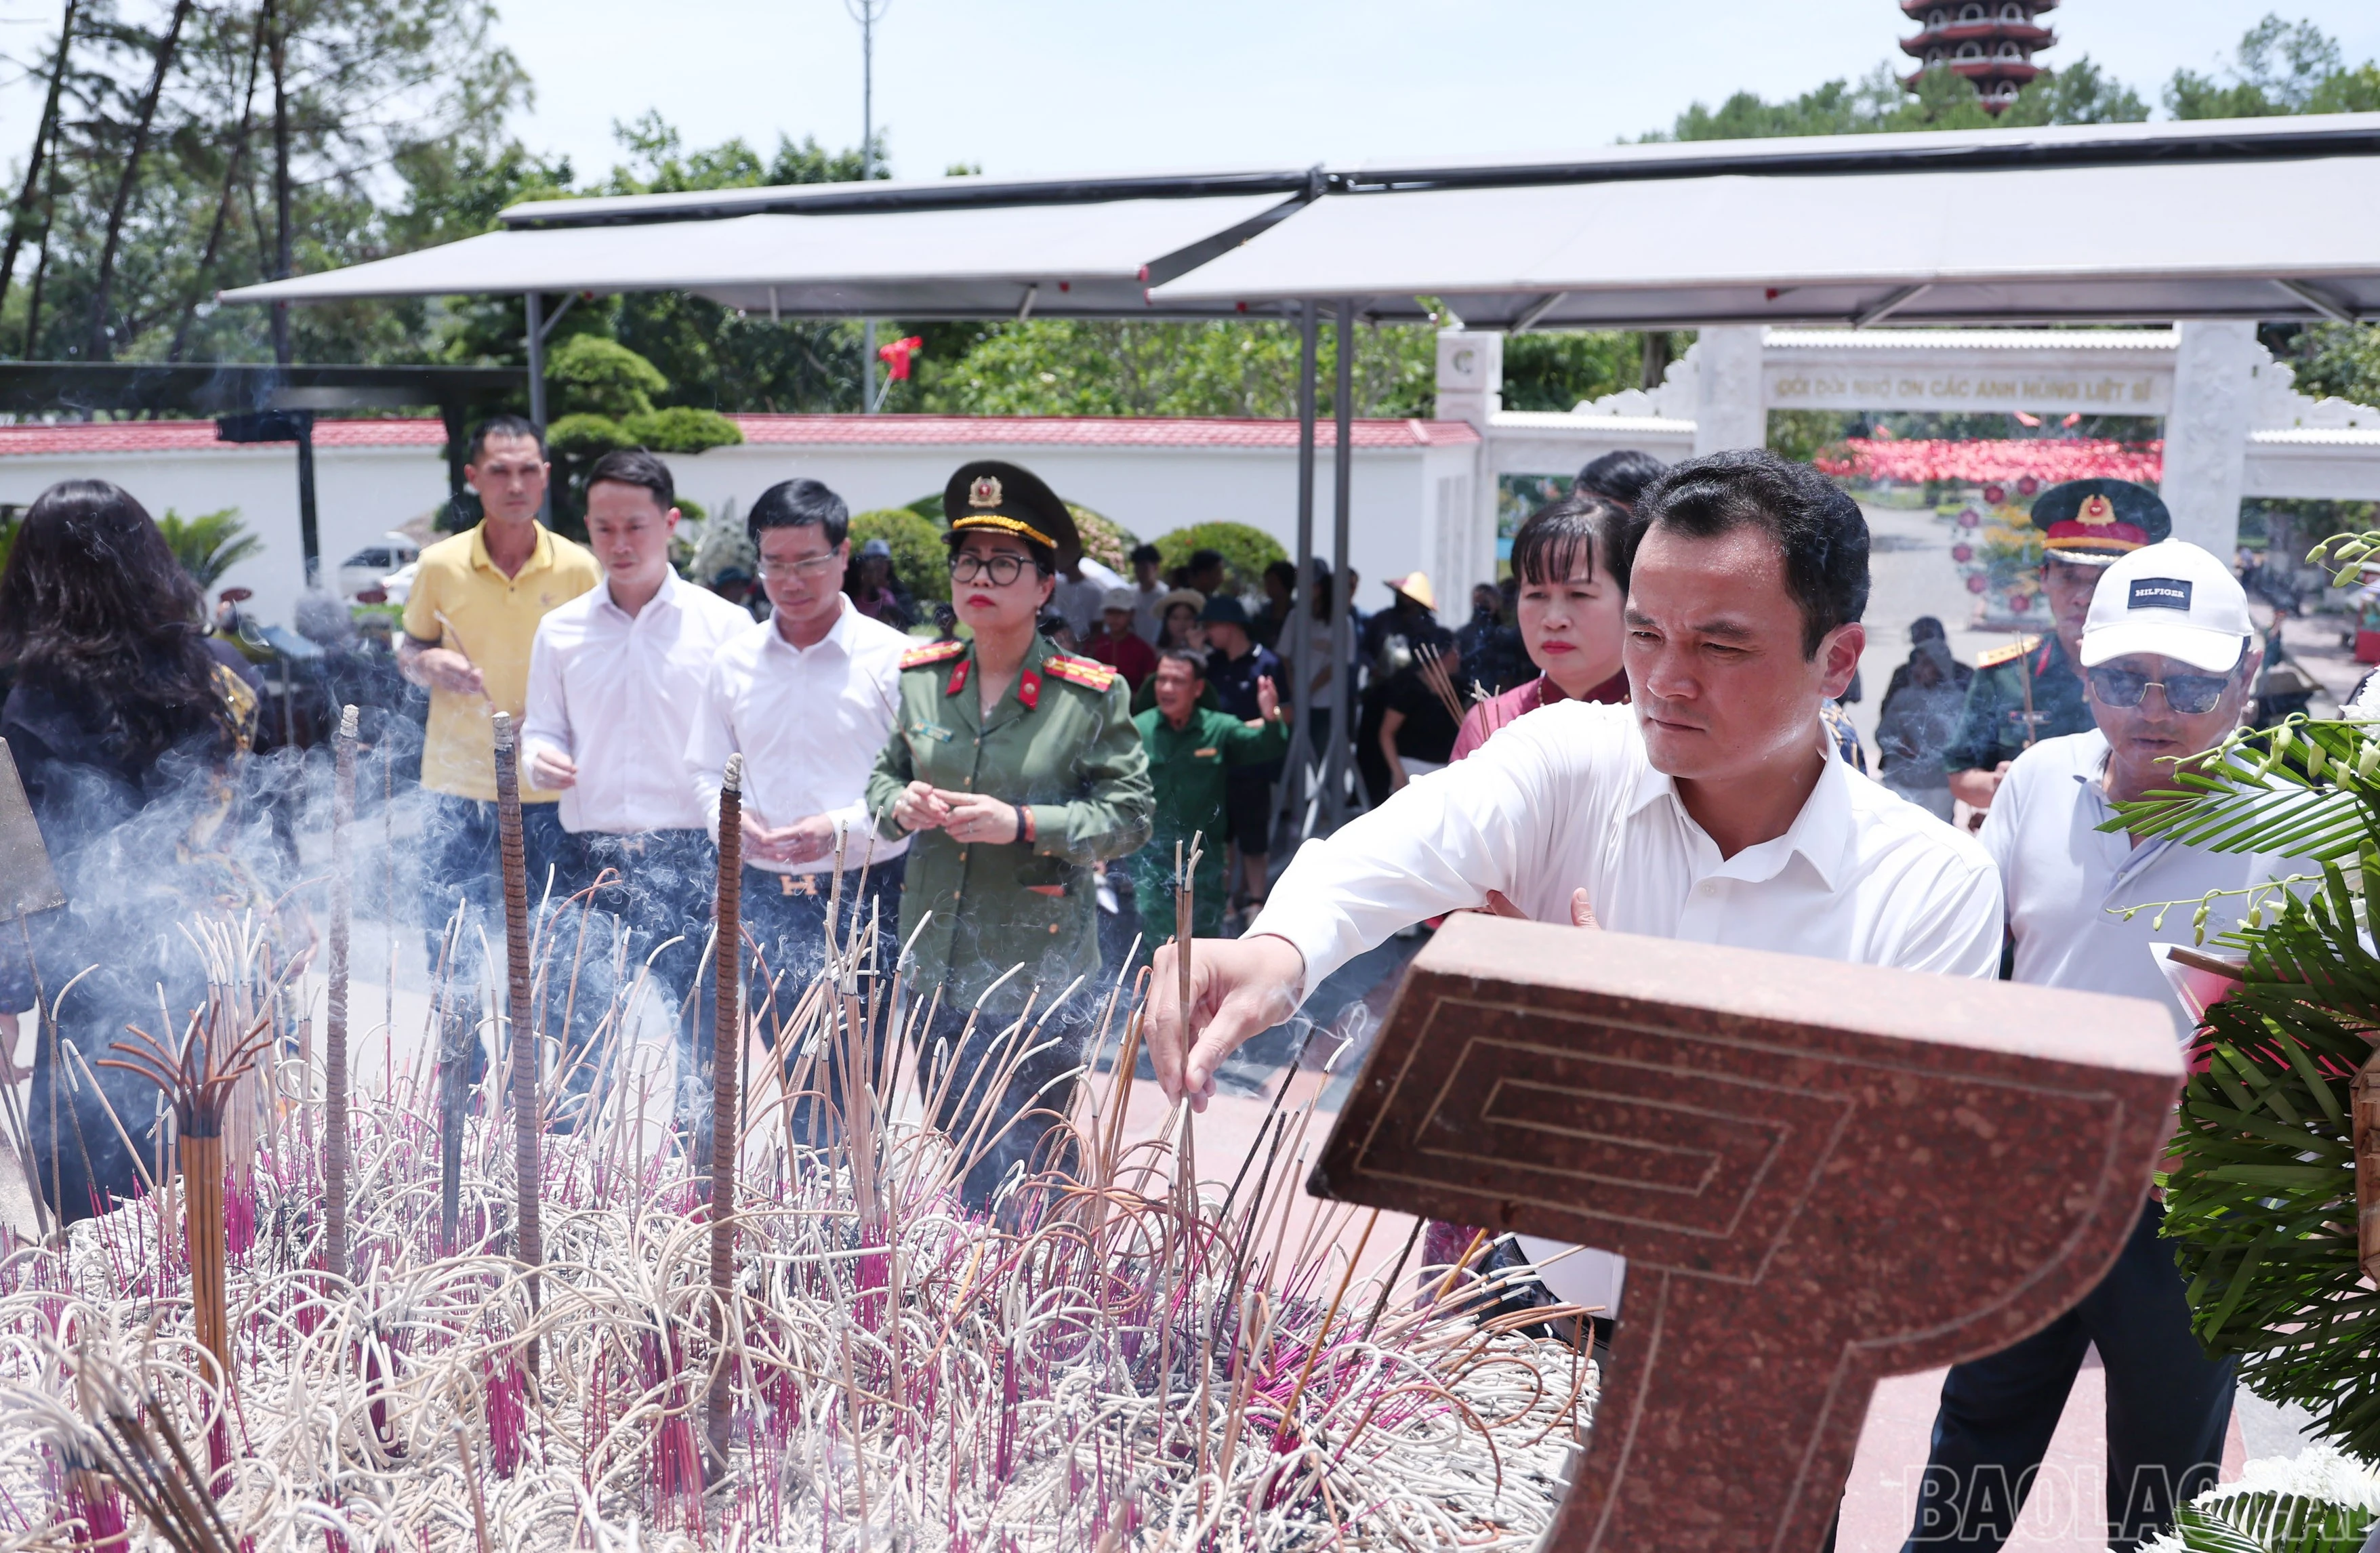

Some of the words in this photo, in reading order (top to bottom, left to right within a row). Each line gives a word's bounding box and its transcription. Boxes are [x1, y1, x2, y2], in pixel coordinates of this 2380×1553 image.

[1931, 373, 1971, 398] CÁC
[1975, 379, 2016, 398] ANH
[2135, 587, 2185, 598] HILFIGER
